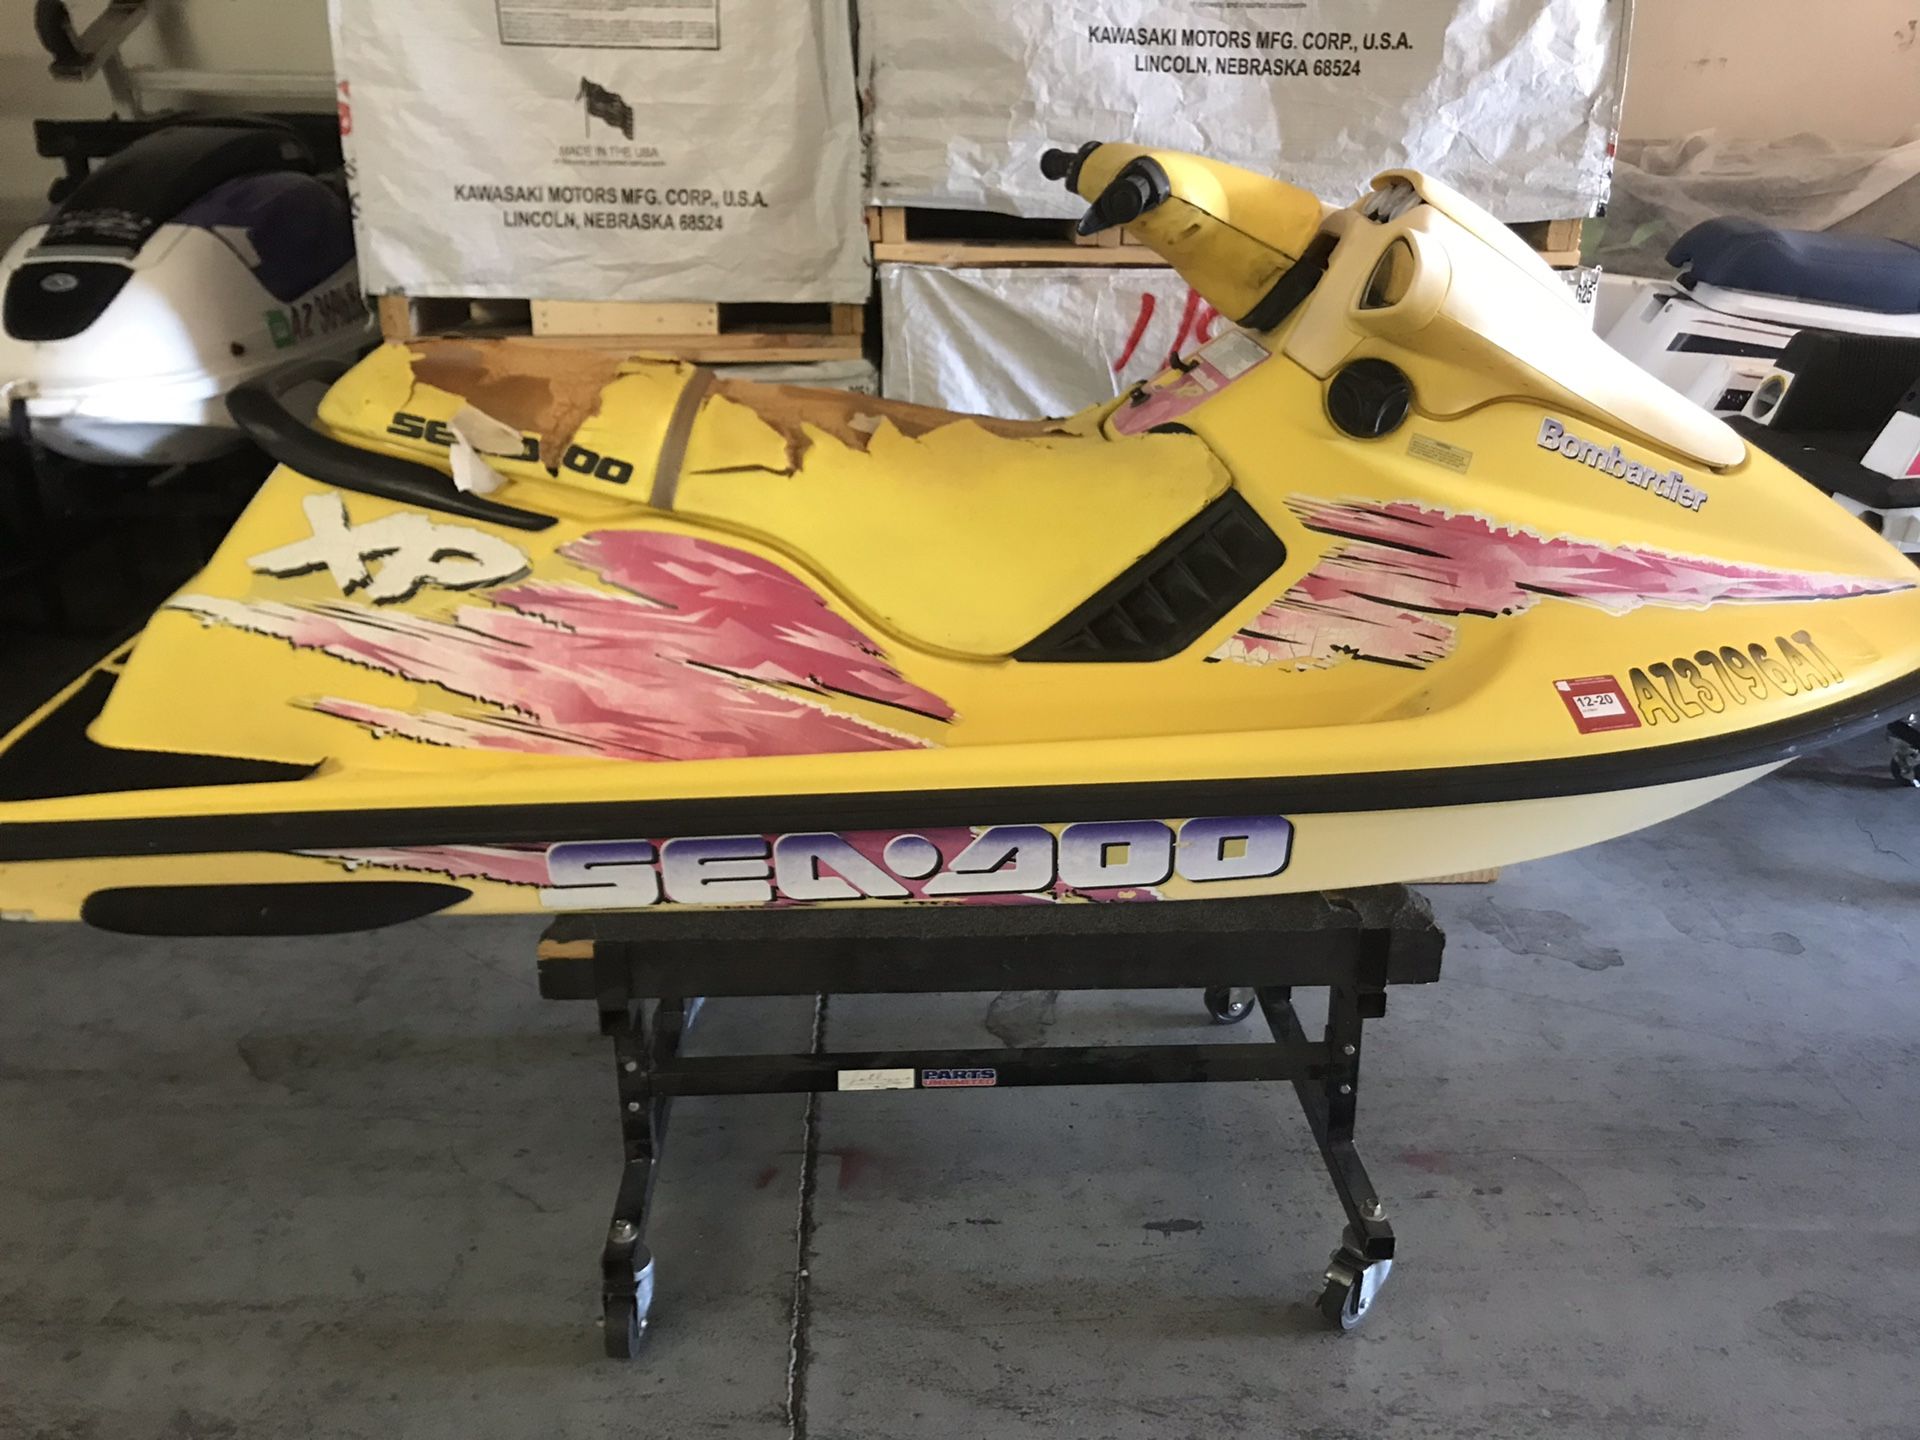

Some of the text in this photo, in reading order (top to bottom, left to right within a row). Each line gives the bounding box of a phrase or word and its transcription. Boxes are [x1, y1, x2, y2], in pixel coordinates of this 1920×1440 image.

[1088, 25, 1414, 53] KAWASAKI MOTORS MFG. CORP., U.S.A.
[1134, 55, 1362, 77] LINCOLN, NEBRASKA 68524
[453, 184, 769, 209] KAWASAKI MOTORS MFG. CORP., U.S.A.
[503, 211, 723, 231] LINCOLN, NEBRASKA 68524
[1537, 416, 1708, 512] Bombardier
[244, 490, 532, 605] XP
[1628, 629, 1845, 726] AZ3796AT
[1576, 694, 1614, 708] 12-20
[923, 1069, 995, 1080] PARTS
